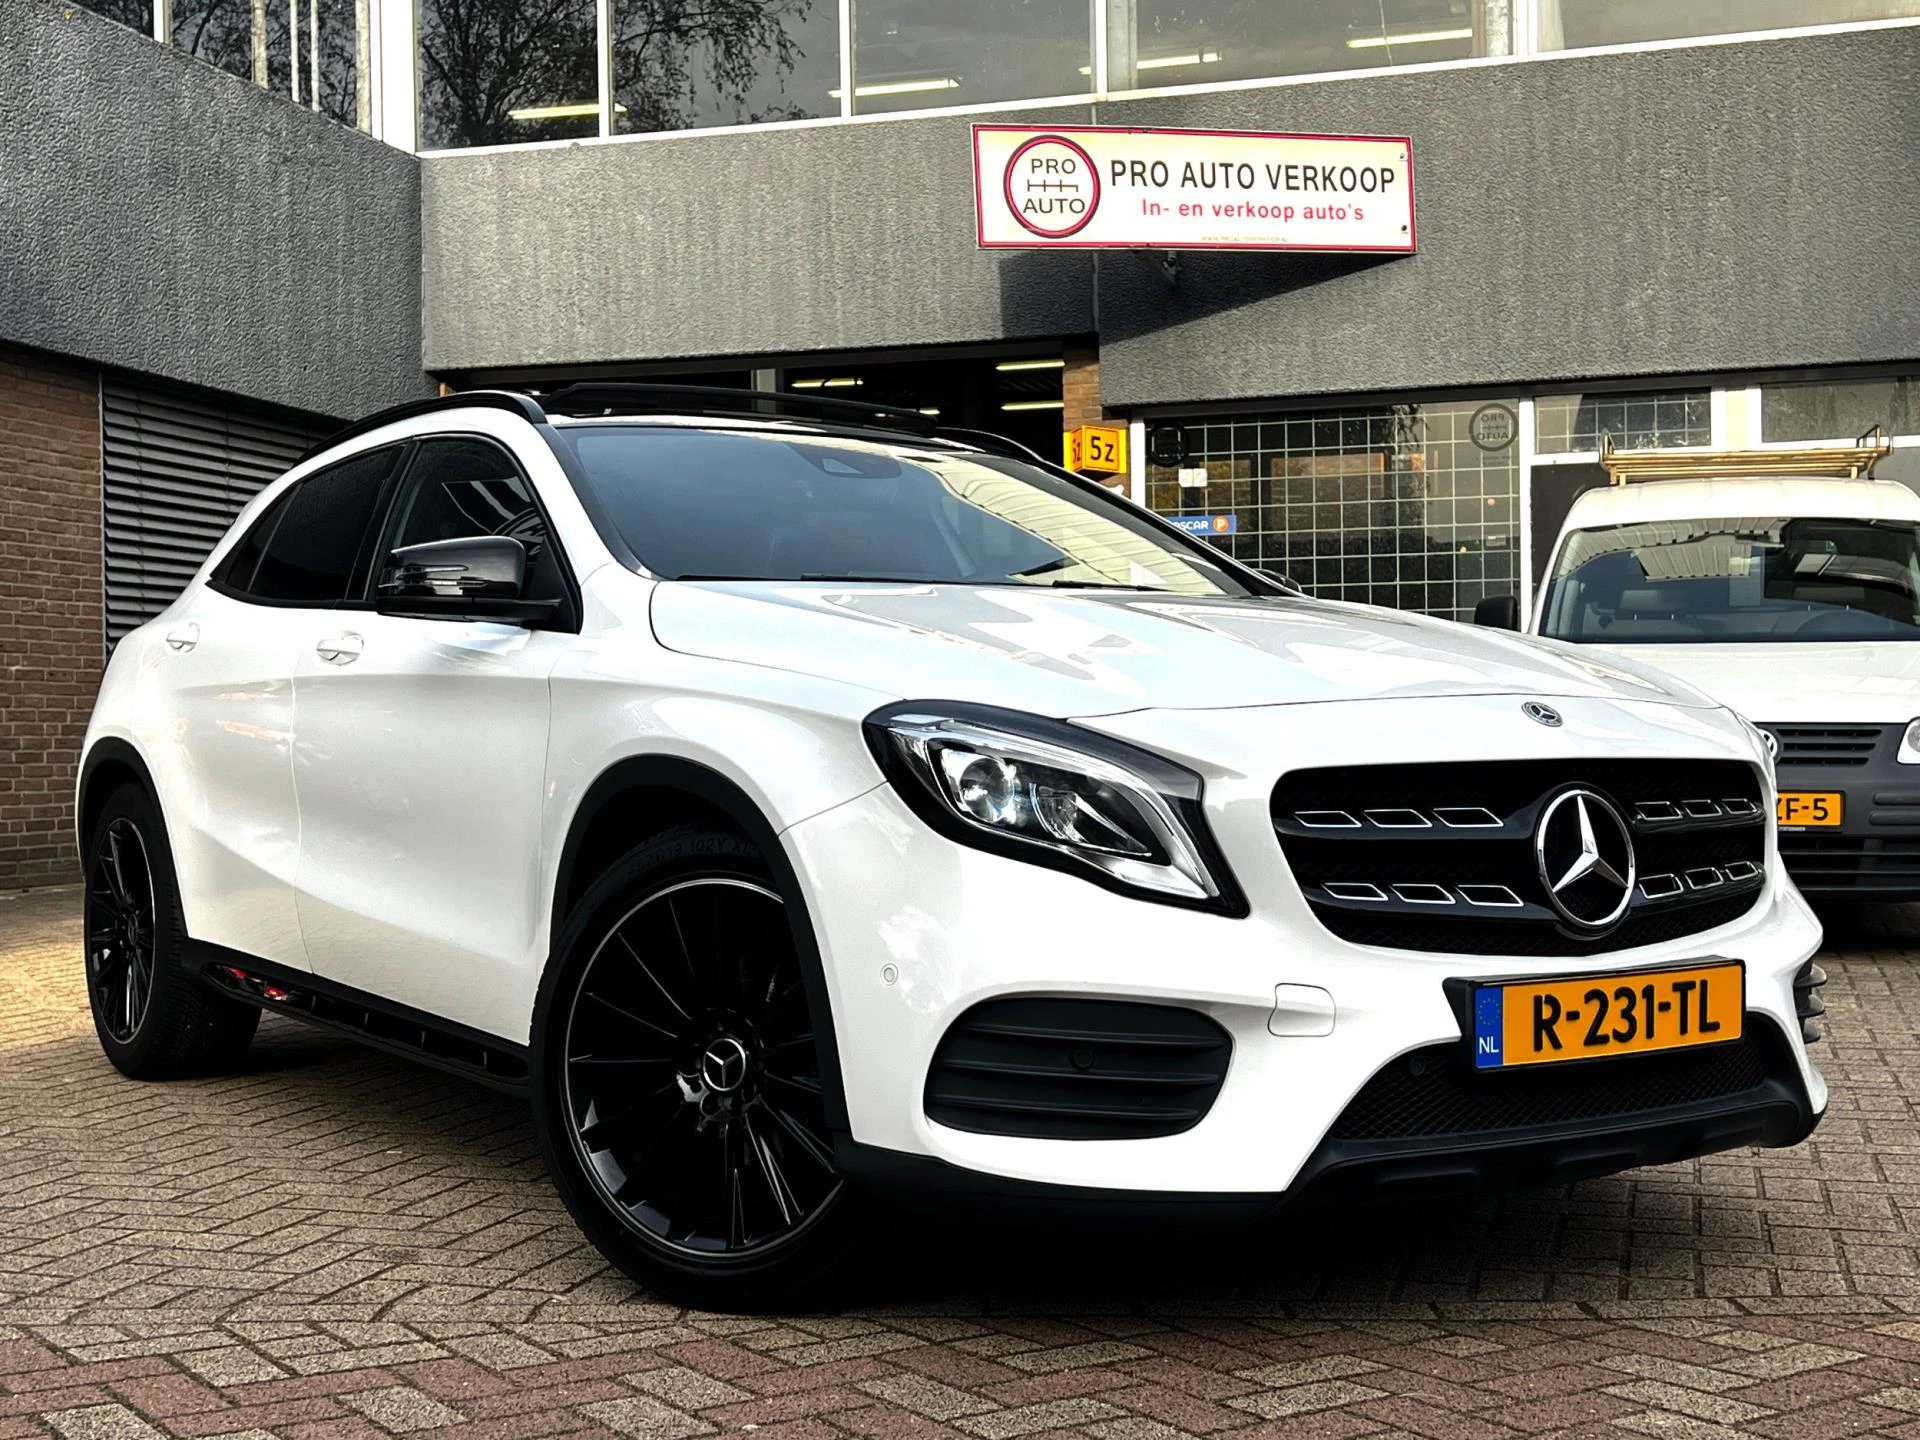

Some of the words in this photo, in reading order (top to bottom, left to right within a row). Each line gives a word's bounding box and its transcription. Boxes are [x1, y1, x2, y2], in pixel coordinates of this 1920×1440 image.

[1031, 158, 1076, 174] PRO
[1111, 159, 1169, 188] PRO
[1180, 161, 1255, 189] AUTO
[1265, 164, 1395, 193] VERKOOP
[1022, 198, 1085, 214] AUTO
[1142, 198, 1170, 216] In-
[1178, 203, 1203, 217] en
[1212, 201, 1295, 223] verkoop
[1303, 204, 1364, 220] auto's
[1532, 979, 1721, 1053] R-231-TL
[1478, 1035, 1500, 1055] NL
